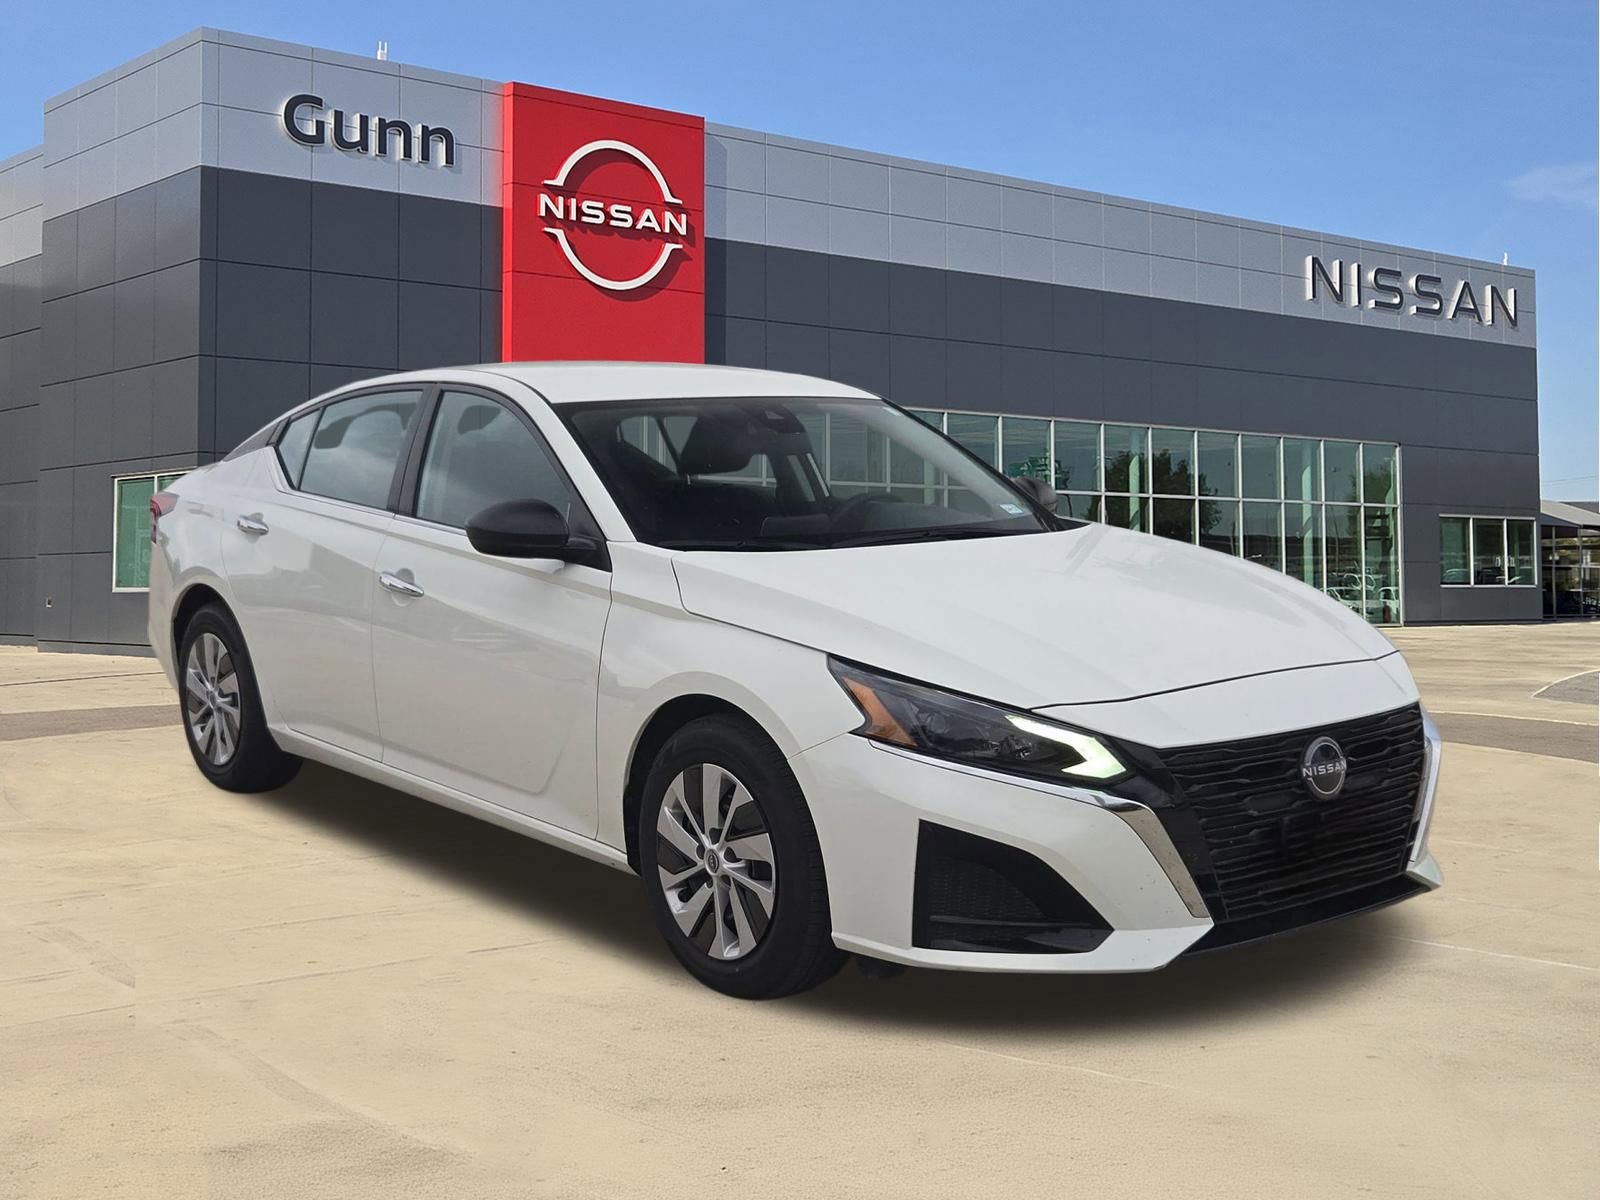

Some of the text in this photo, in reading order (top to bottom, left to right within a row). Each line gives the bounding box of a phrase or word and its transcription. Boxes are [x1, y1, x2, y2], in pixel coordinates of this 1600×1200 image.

[281, 94, 456, 168] Gunn
[537, 193, 687, 235] NISSAN
[1305, 255, 1518, 328] NISSAN
[1302, 760, 1347, 777] NISSAN
